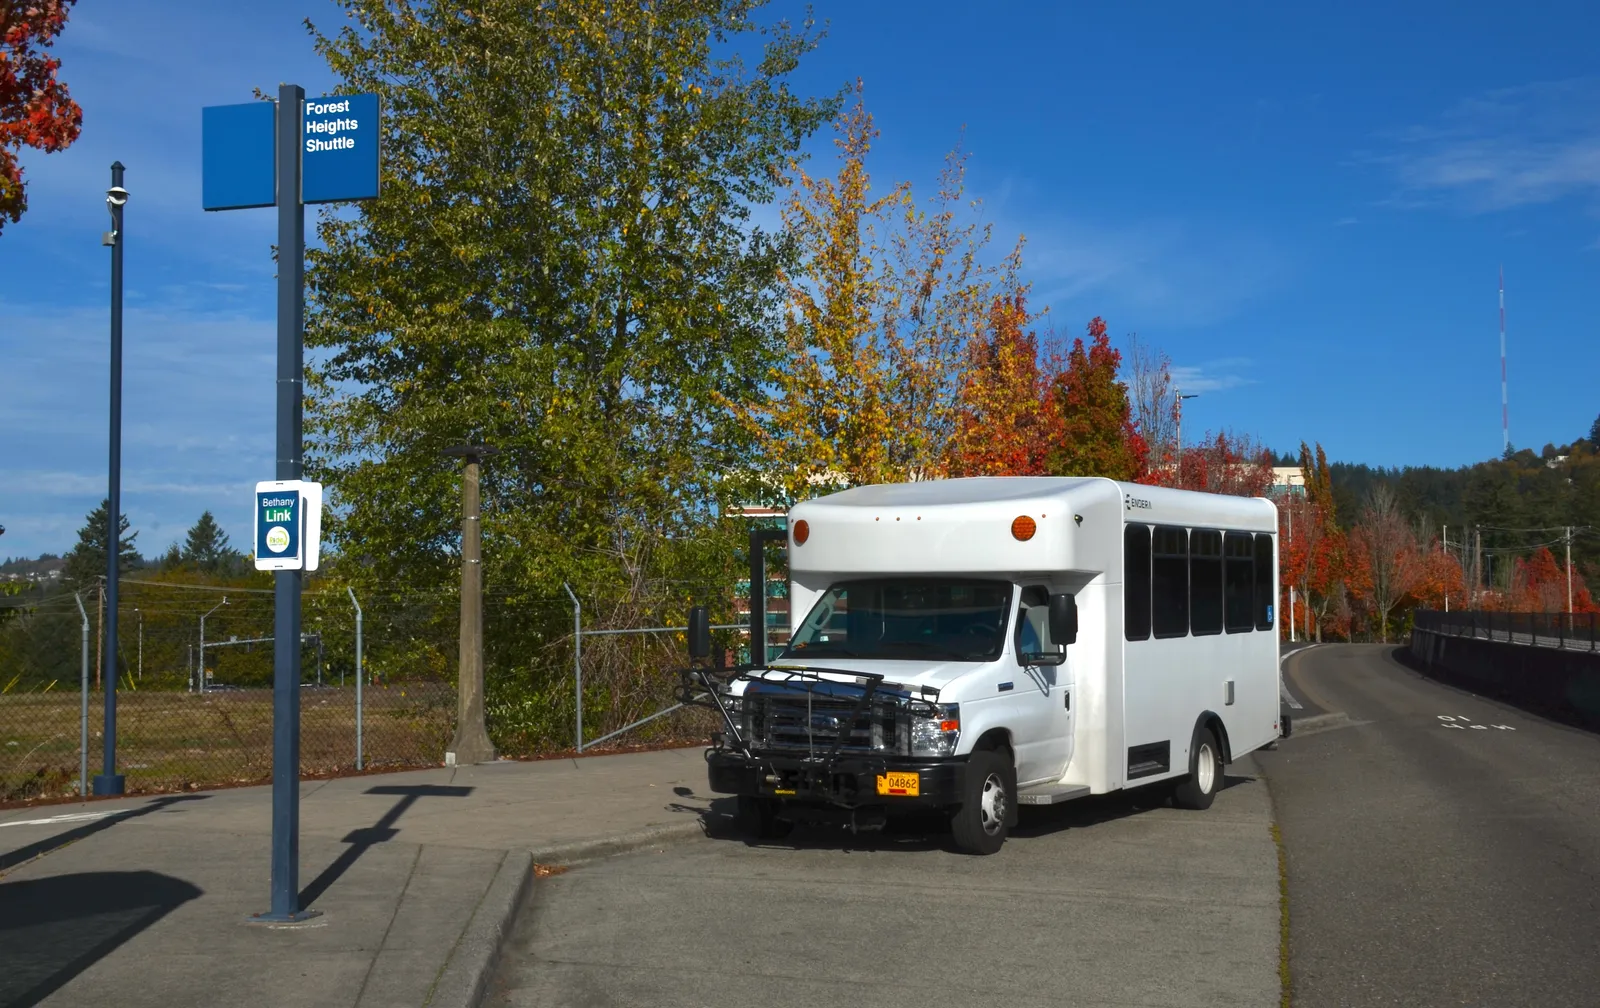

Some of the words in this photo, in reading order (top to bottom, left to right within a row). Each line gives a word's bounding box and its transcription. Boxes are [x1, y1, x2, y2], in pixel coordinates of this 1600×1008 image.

[306, 100, 350, 115] Forest
[306, 118, 358, 134] Heights
[306, 136, 355, 152] Shuttle
[262, 498, 295, 508] Bethany
[266, 509, 291, 522] Link
[888, 777, 917, 789] 04862
